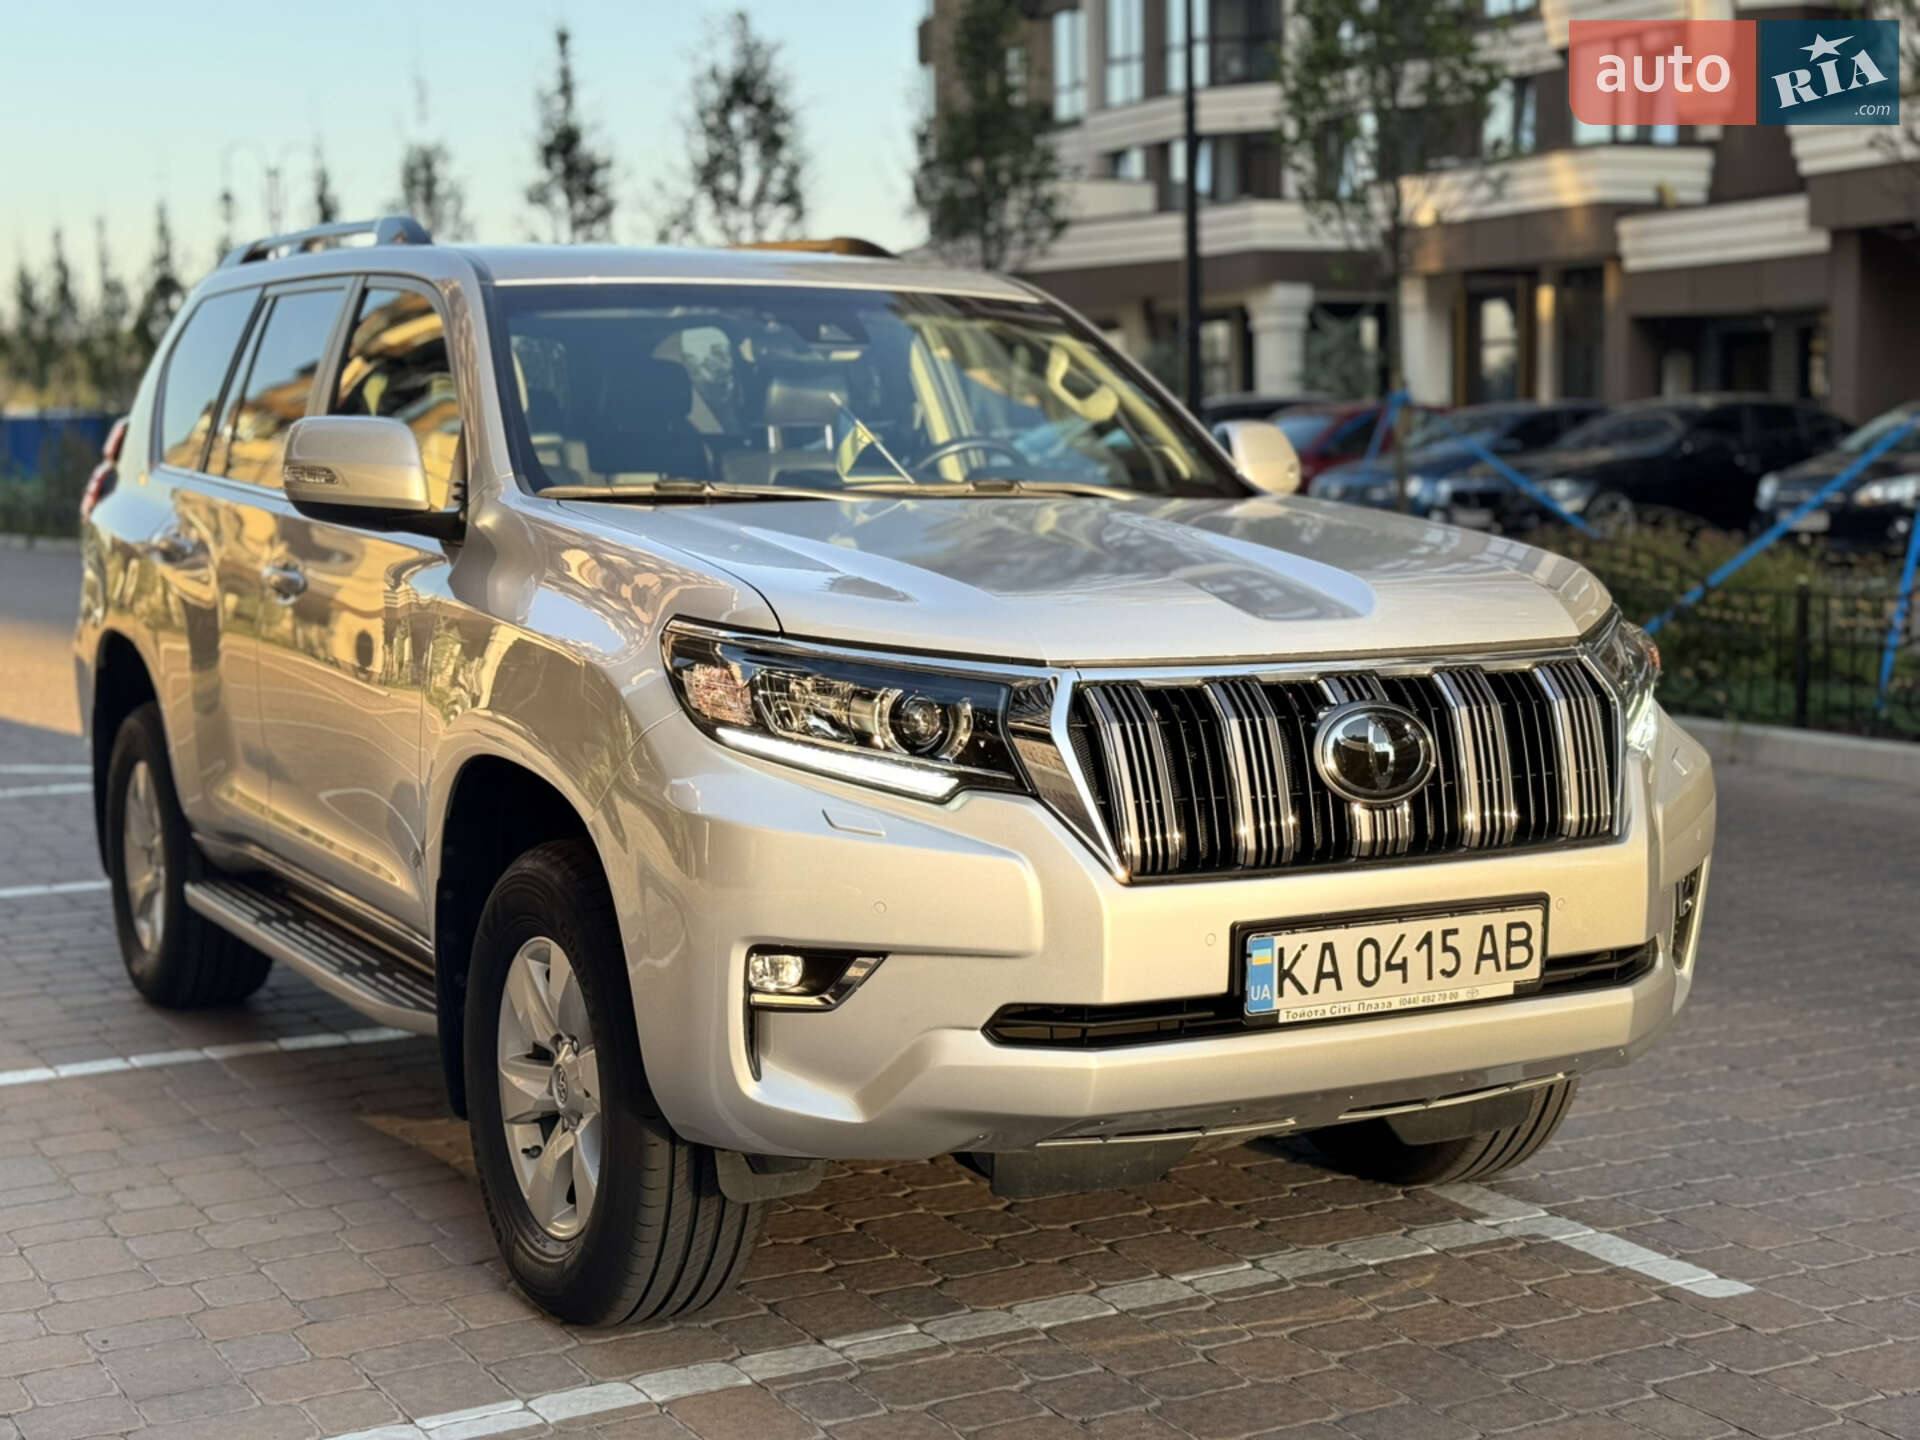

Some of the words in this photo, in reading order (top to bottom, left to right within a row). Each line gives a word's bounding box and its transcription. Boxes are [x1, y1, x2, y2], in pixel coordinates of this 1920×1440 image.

[1277, 942, 1343, 998] KA
[1357, 927, 1461, 988] 0415
[1474, 921, 1534, 975] AB
[1250, 983, 1272, 1001] UA
[1284, 1008, 1326, 1020] Тойота
[1357, 1000, 1393, 1012] Плаза
